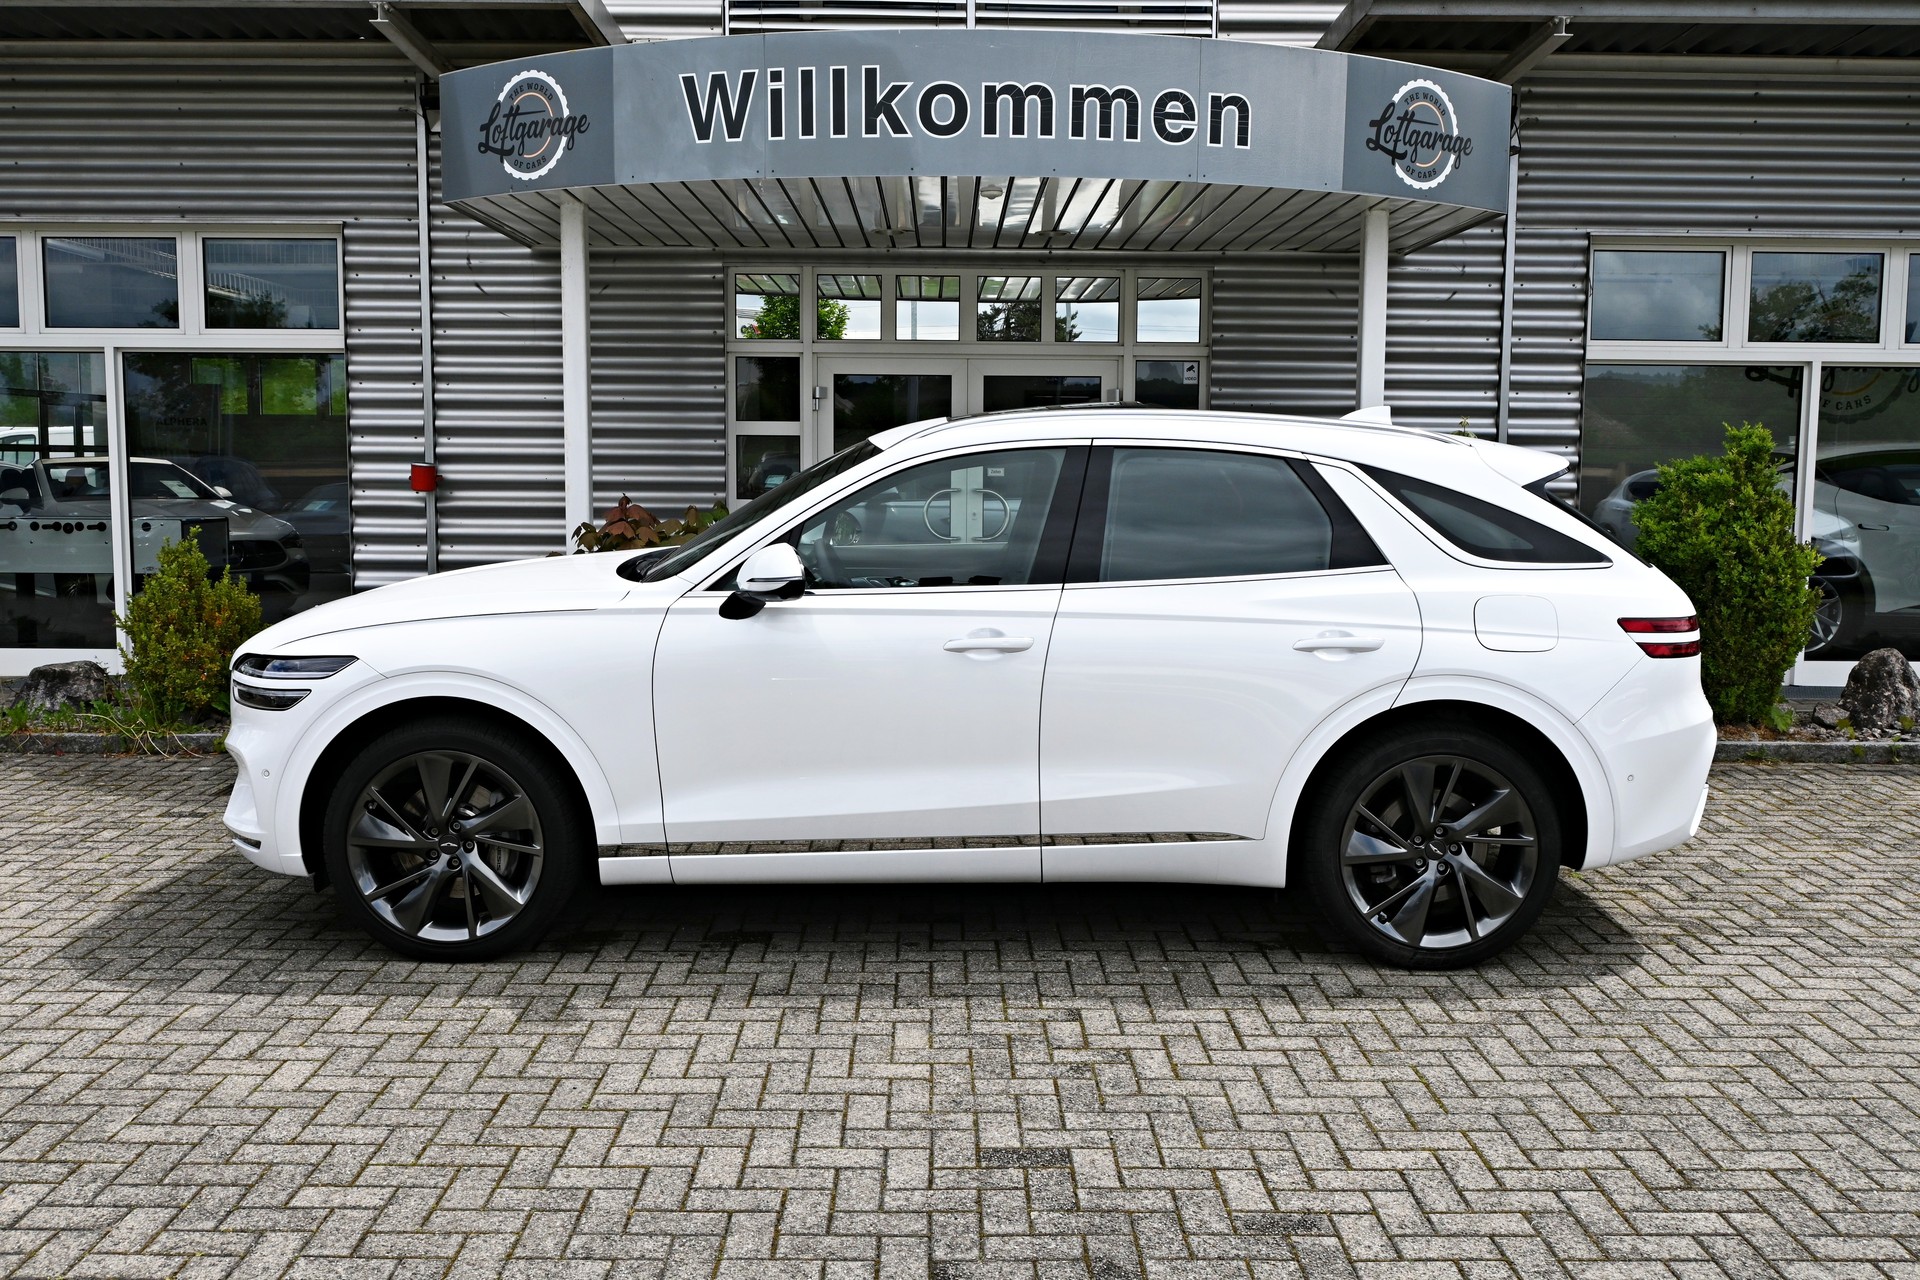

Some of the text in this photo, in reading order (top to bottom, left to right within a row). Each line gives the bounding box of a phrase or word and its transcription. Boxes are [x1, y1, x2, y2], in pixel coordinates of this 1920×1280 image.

[508, 82, 554, 101] THE WORLD
[678, 64, 1252, 150] Willkommen
[1404, 92, 1446, 117] THE WORLD
[478, 101, 590, 163] Loftgarage
[1366, 102, 1473, 169] Loftgarage
[513, 155, 547, 170] OF CARS
[1405, 165, 1437, 179] OF CARS
[1835, 394, 1872, 411] CARS
[156, 417, 207, 426] ALPHERA
